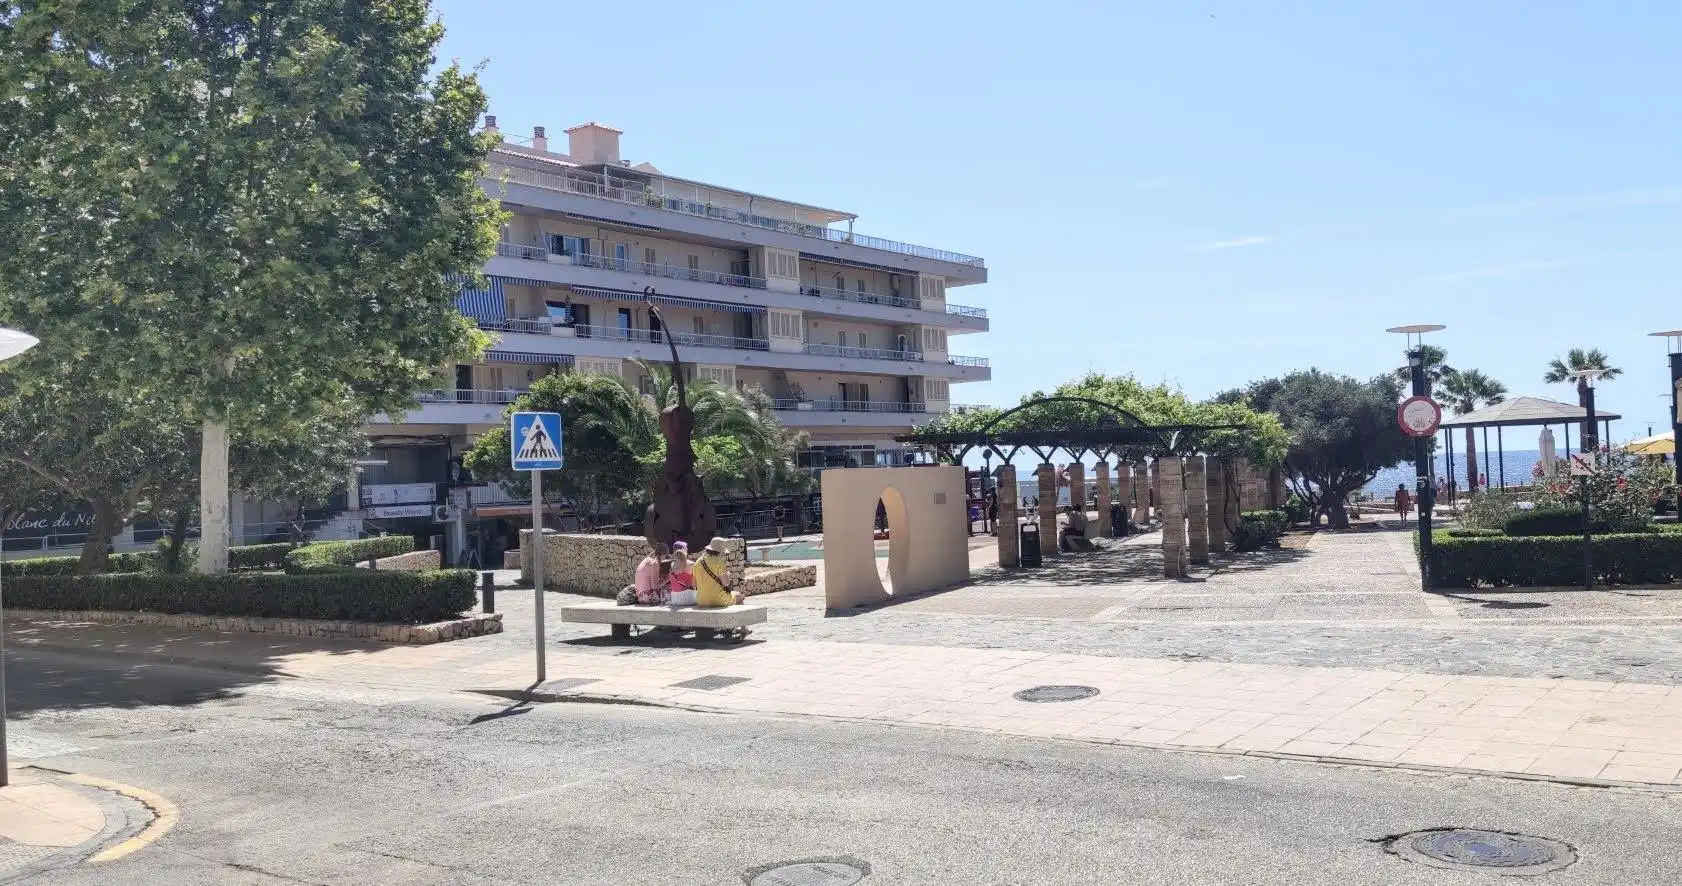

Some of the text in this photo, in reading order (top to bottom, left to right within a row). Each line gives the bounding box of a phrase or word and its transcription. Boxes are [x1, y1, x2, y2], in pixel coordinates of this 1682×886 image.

[404, 508, 422, 516] World
[53, 511, 72, 527] du
[74, 512, 96, 526] Nil
